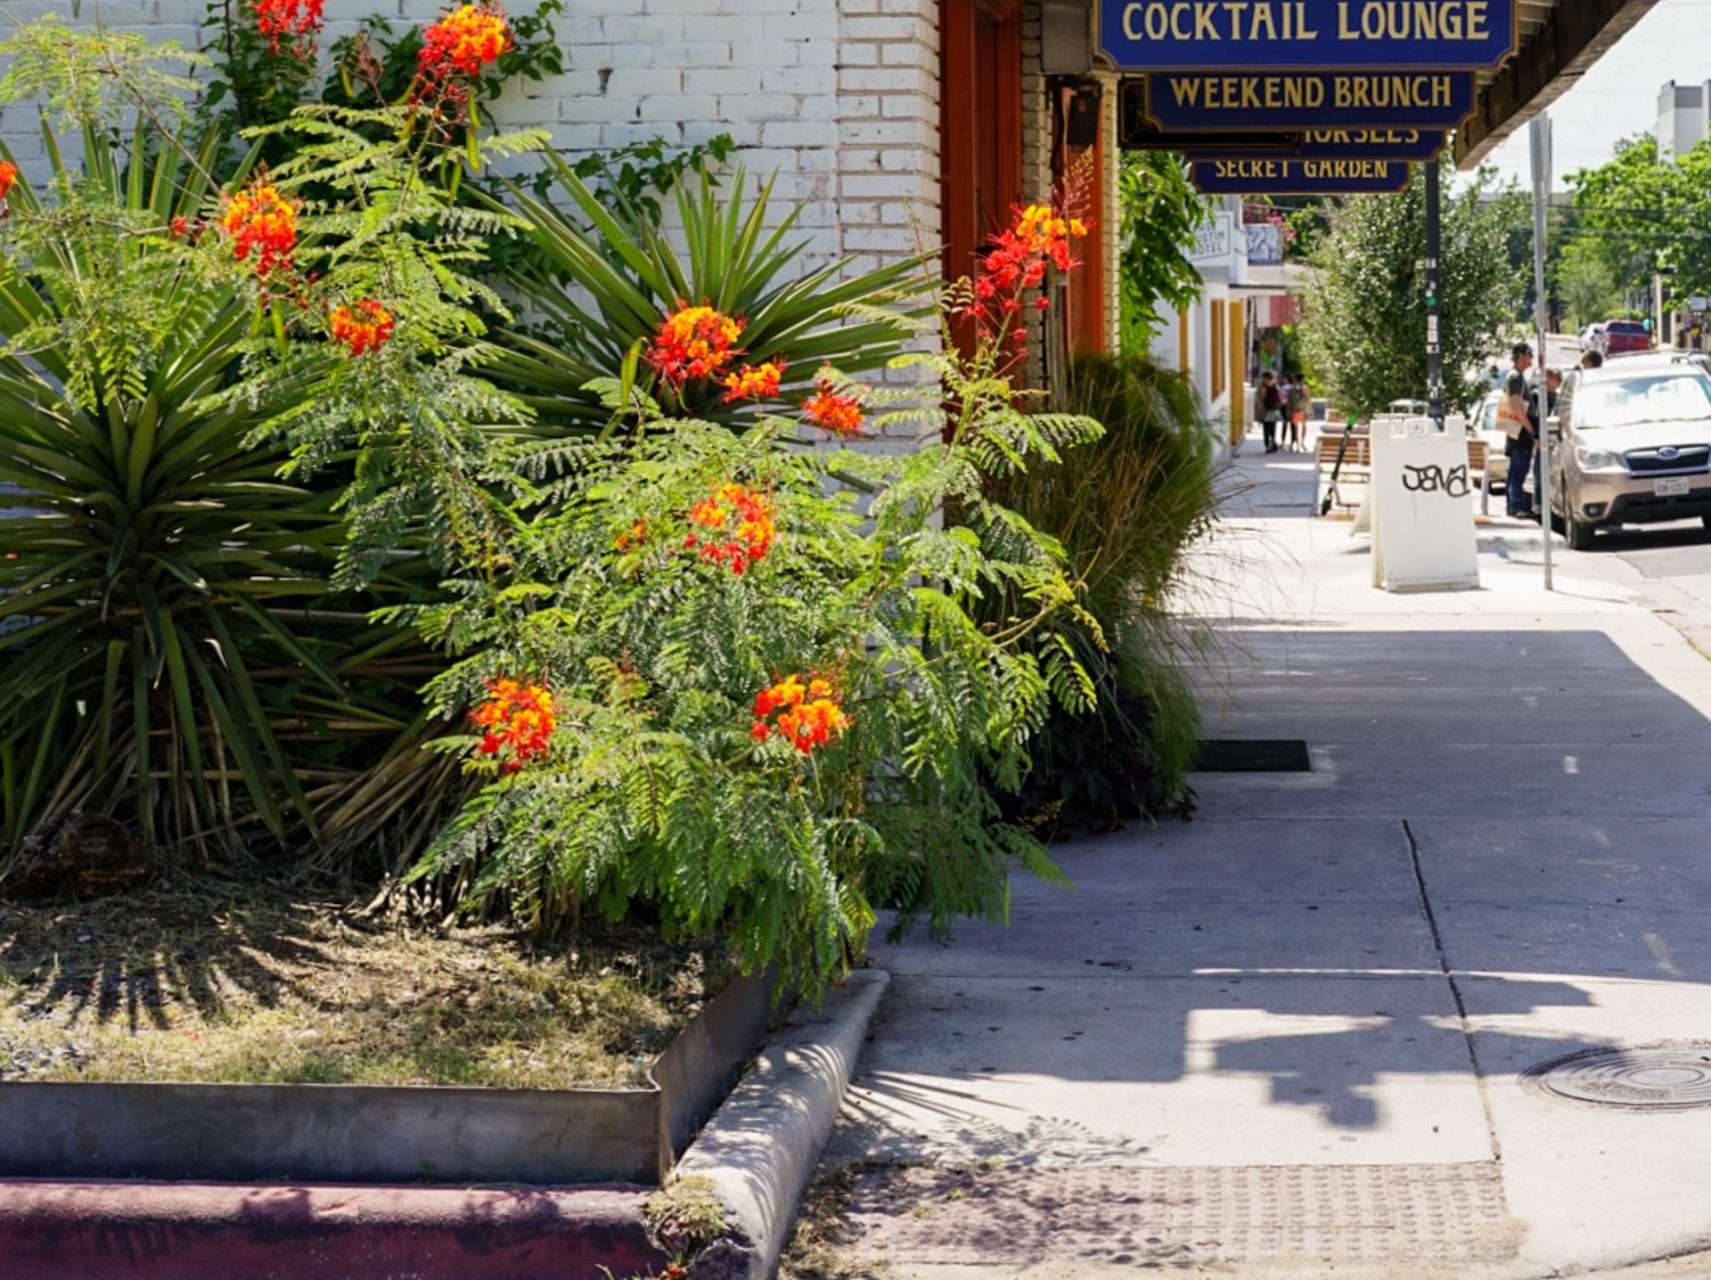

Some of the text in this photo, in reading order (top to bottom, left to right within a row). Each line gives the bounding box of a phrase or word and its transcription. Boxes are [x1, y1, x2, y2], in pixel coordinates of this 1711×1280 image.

[1122, 1, 1490, 40] COCKTAIL LOUNGE
[1170, 76, 1452, 108] WEEKEND BRUNCH
[1215, 160, 1388, 178] SECRET GARDEN
